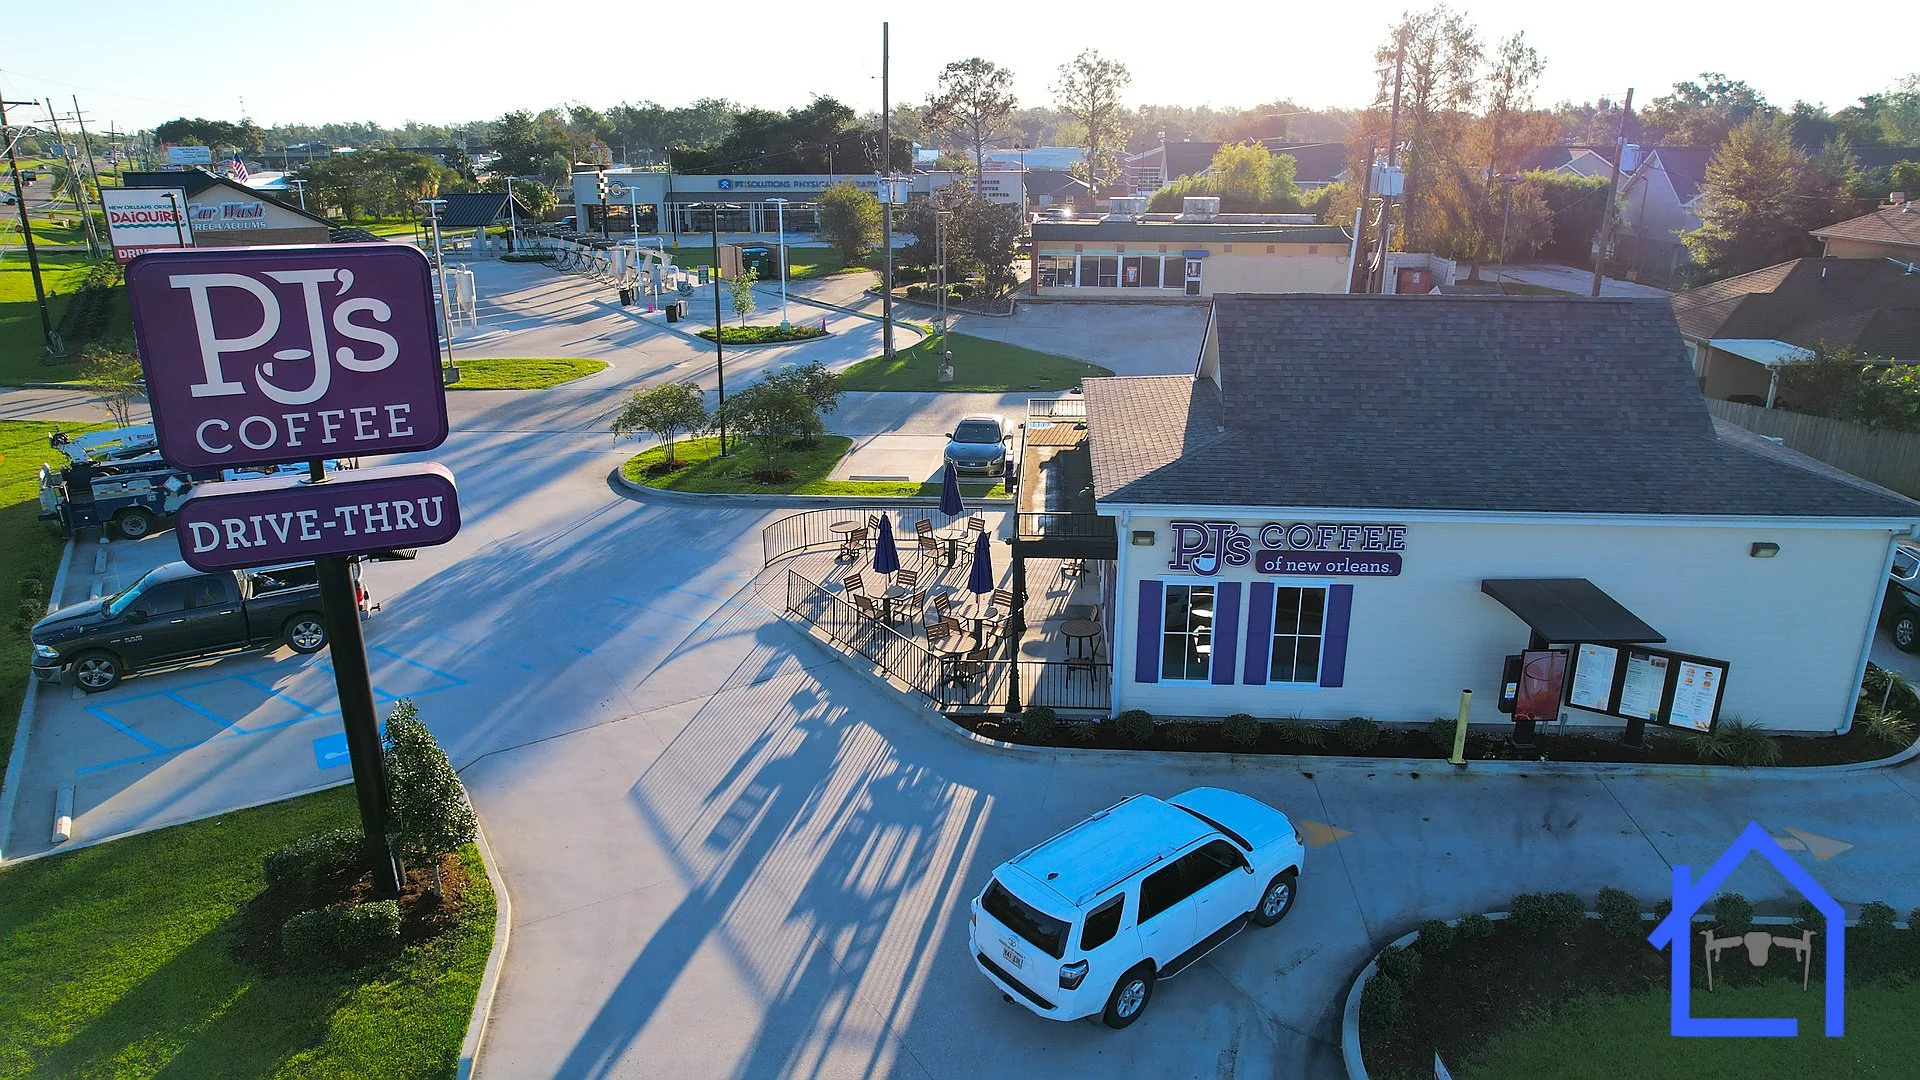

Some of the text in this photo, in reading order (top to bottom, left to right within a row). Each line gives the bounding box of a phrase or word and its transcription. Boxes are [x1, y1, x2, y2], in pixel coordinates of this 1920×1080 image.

[746, 180, 791, 189] SOLUTIONS
[793, 180, 834, 189] PHYSICA
[189, 203, 264, 220] Car Wash
[218, 221, 267, 230] VACUUMS
[169, 268, 399, 406] PJ's
[195, 403, 414, 454] COFFEE
[189, 496, 444, 554] DRIVE-THRU
[1258, 523, 1409, 552] COFFEE
[1168, 521, 1253, 577] PJ's
[1264, 556, 1284, 573] of
[1286, 559, 1322, 573] new
